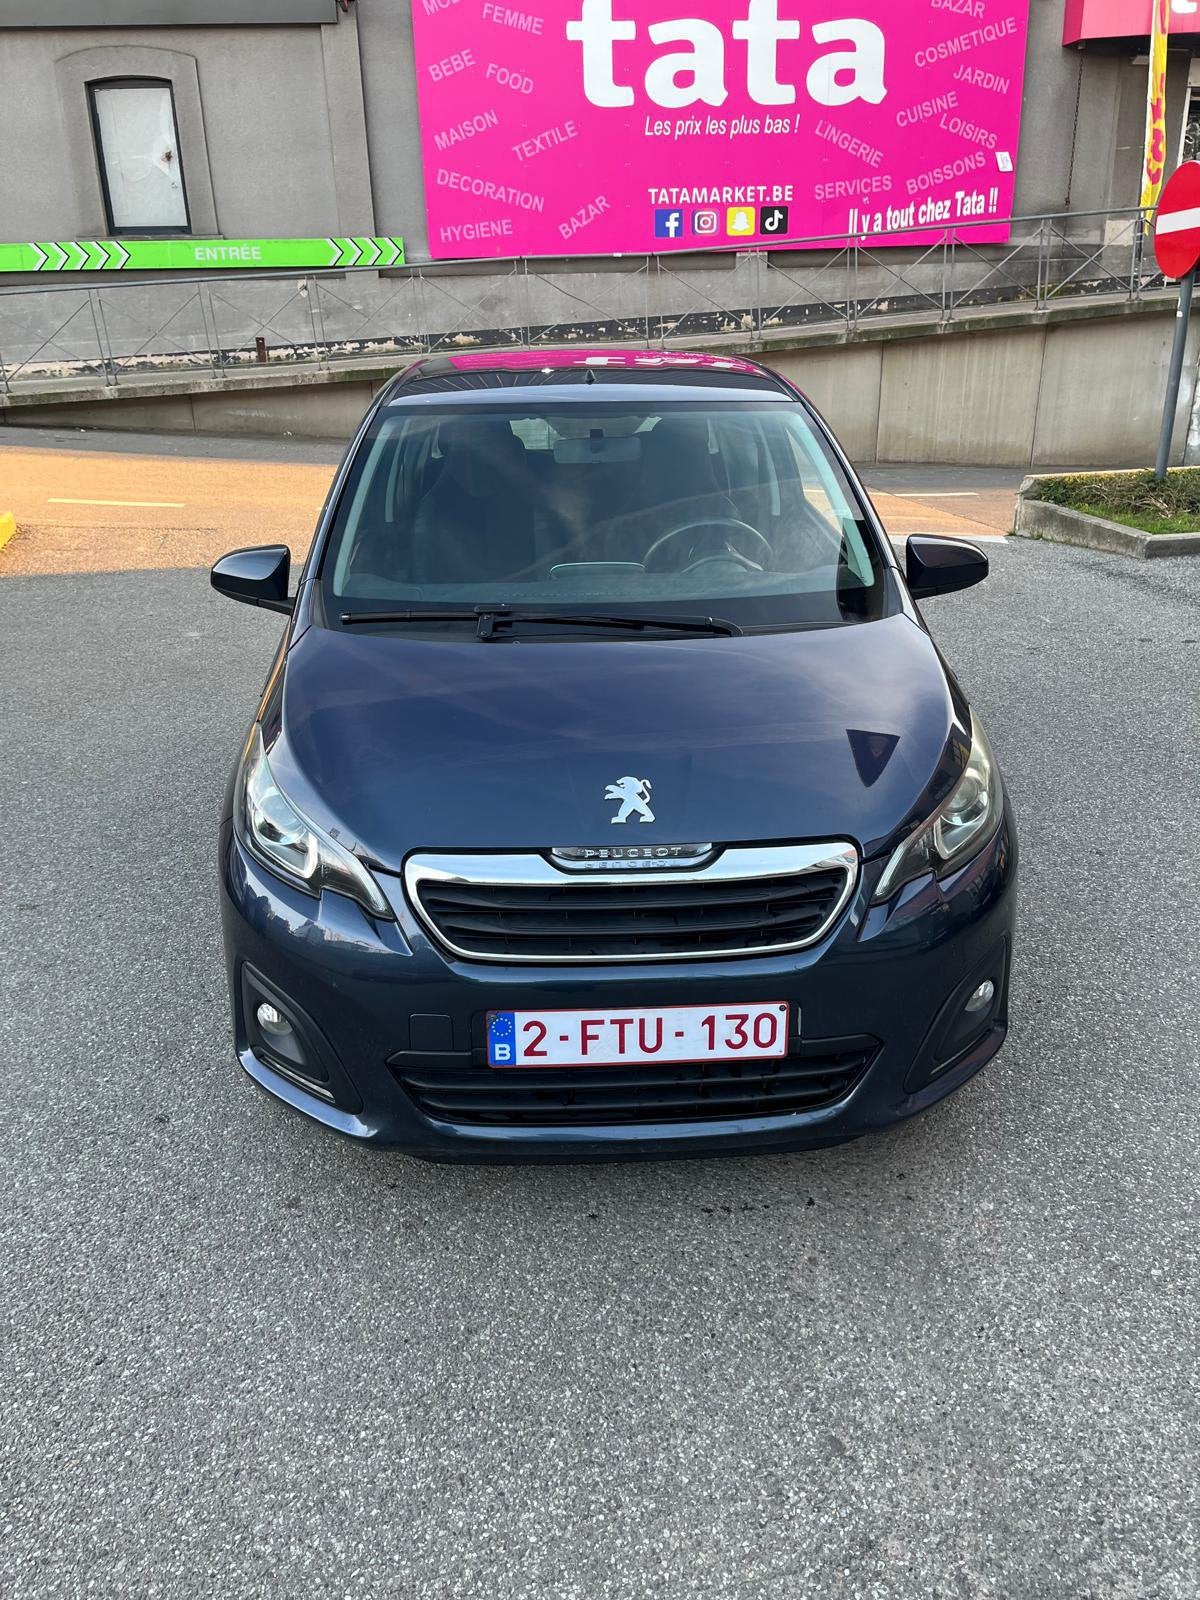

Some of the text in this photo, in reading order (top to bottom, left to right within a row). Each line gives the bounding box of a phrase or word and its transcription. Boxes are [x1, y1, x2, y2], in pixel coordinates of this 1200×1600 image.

[482, 3, 544, 35] FEMME
[930, 0, 986, 19] BAZAR
[566, 0, 887, 108] tata
[914, 17, 1018, 68] COSMETIQUE
[428, 49, 476, 82] BEBE
[485, 63, 534, 95] FOOD
[953, 64, 1011, 94] JARDIN
[896, 91, 959, 127] CUISINE
[434, 109, 499, 151] MAISON
[512, 120, 578, 161] TEXTILE
[645, 115, 671, 136] Les
[674, 115, 702, 140] prix
[705, 115, 727, 135] les
[730, 114, 760, 139] plus
[764, 114, 791, 134] bas
[939, 113, 998, 150] LOISIRS
[814, 120, 884, 168] LINGERIE
[814, 175, 893, 200] SERVICES
[906, 151, 986, 194] BOISSONS
[436, 168, 545, 212] DECORATION
[648, 185, 794, 204] TATAMARKET.BE
[440, 219, 513, 243] HYGIENE
[558, 195, 611, 240] BAZAR
[861, 214, 871, 241] y
[873, 212, 883, 232] a
[886, 201, 914, 230] tout
[918, 196, 951, 224] chez
[955, 190, 985, 217] Tata
[194, 241, 262, 261] ENTRÉE
[584, 847, 682, 859] PEUGEOT
[494, 1043, 511, 1061] B
